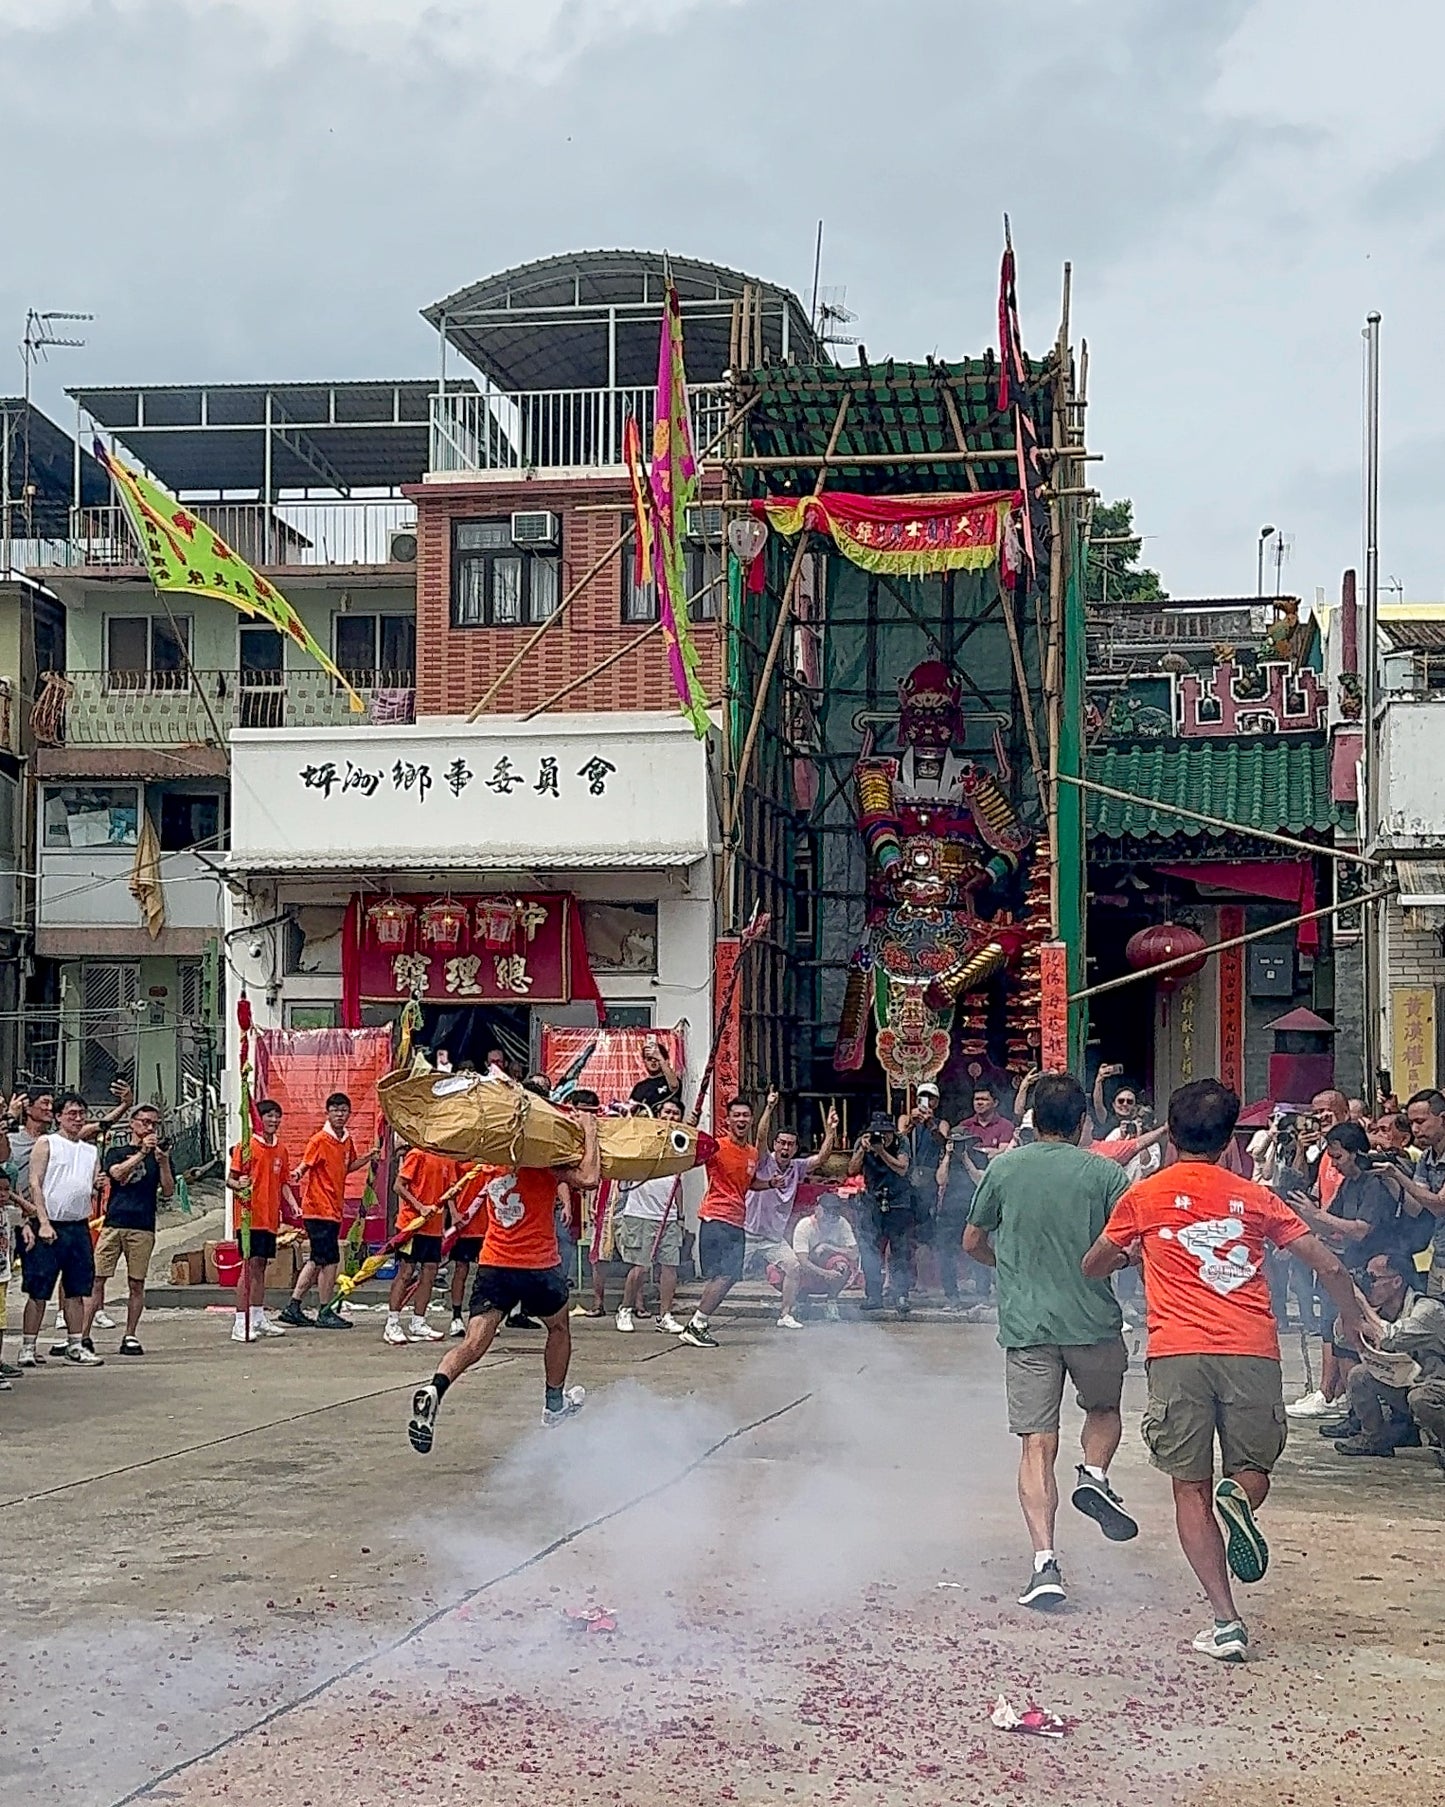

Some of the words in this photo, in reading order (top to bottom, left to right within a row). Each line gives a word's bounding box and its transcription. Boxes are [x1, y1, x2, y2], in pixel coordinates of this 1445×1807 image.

[299, 755, 617, 803] 坪洲鄉事委員會
